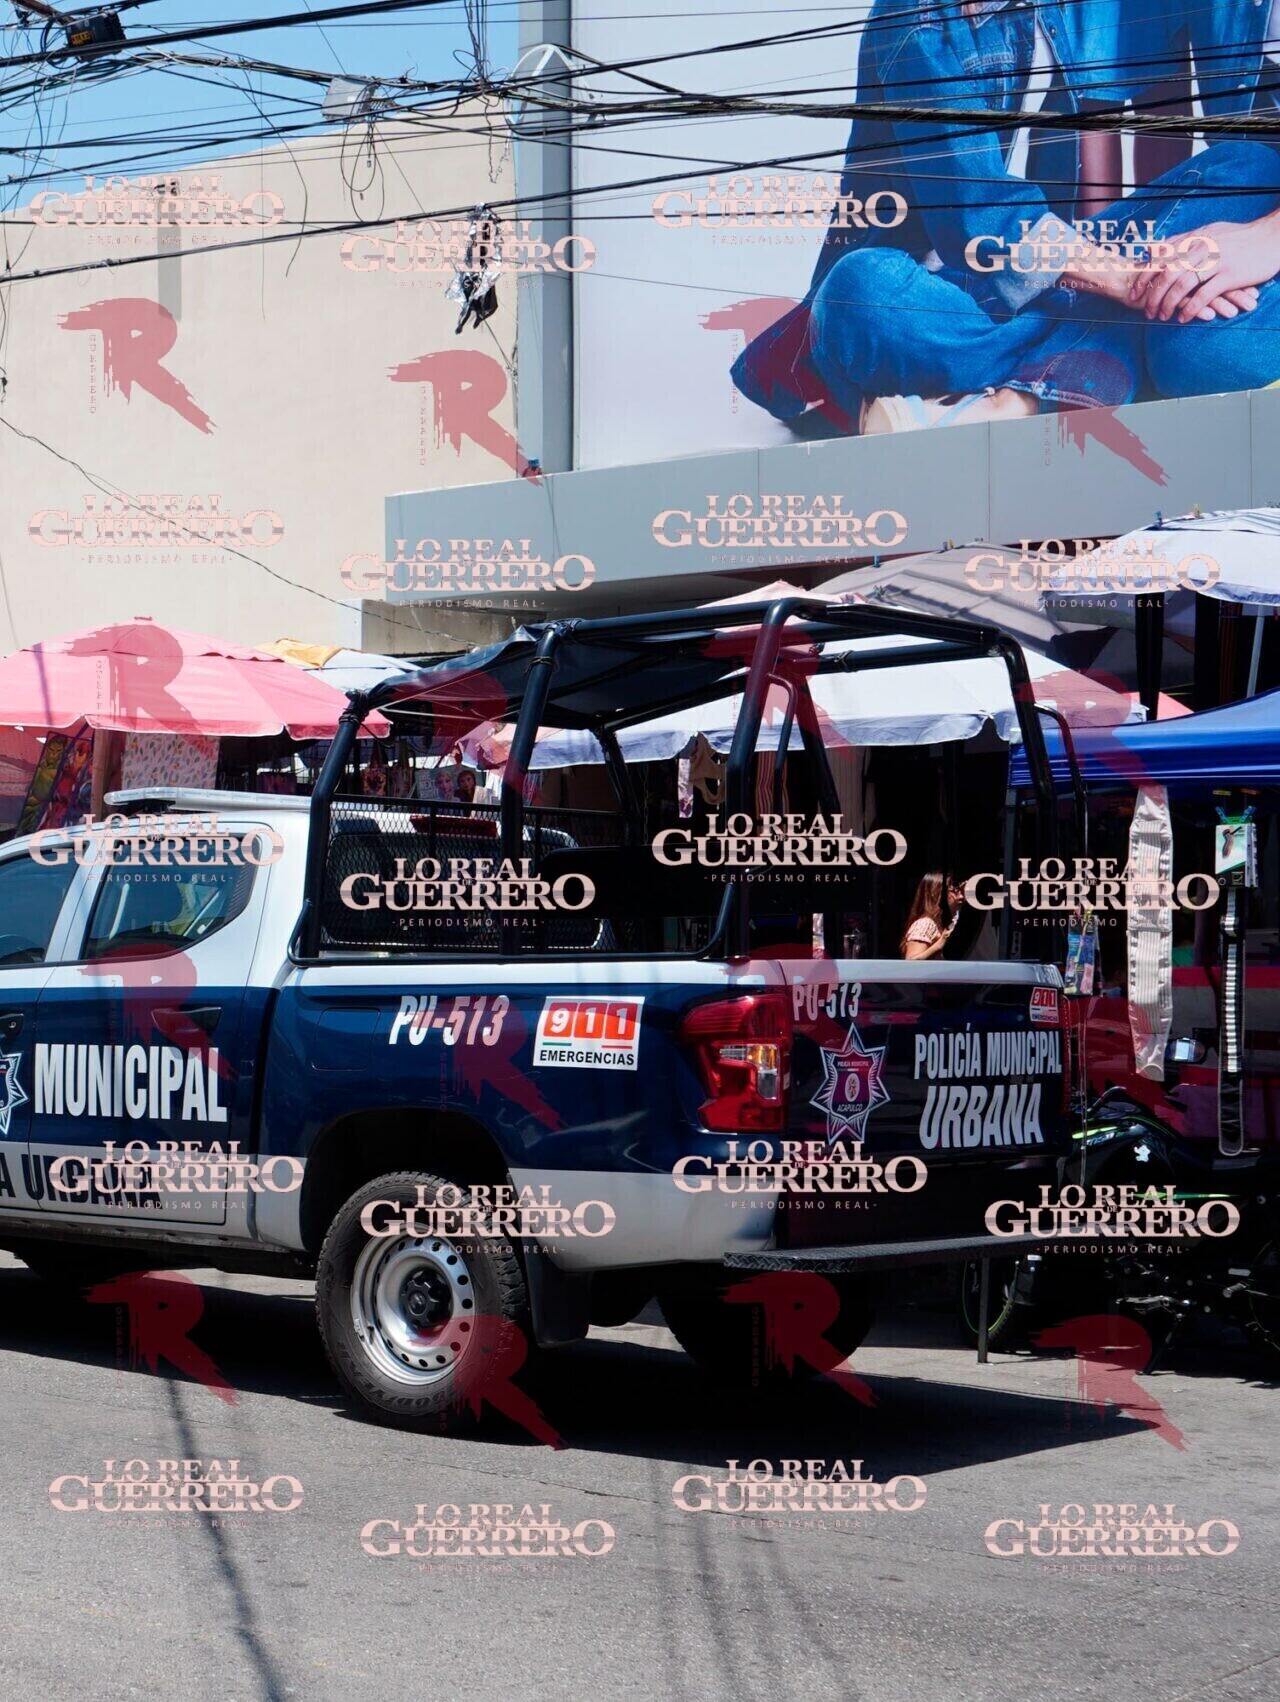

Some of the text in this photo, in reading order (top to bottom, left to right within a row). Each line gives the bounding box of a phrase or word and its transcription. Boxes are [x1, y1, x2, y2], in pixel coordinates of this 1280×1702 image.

[389, 995, 510, 1046] PU-513
[550, 1006, 629, 1035] 911
[793, 976, 862, 1021] PU-513
[1033, 991, 1055, 1005] 911
[540, 1049, 635, 1066] EMERGENCIAS
[914, 1023, 1062, 1080] POLICÍA MUNICIPAL
[35, 1043, 227, 1122] MUNICIPAL
[920, 1083, 1044, 1150] URBANA
[21, 1153, 164, 1210] URBANA
